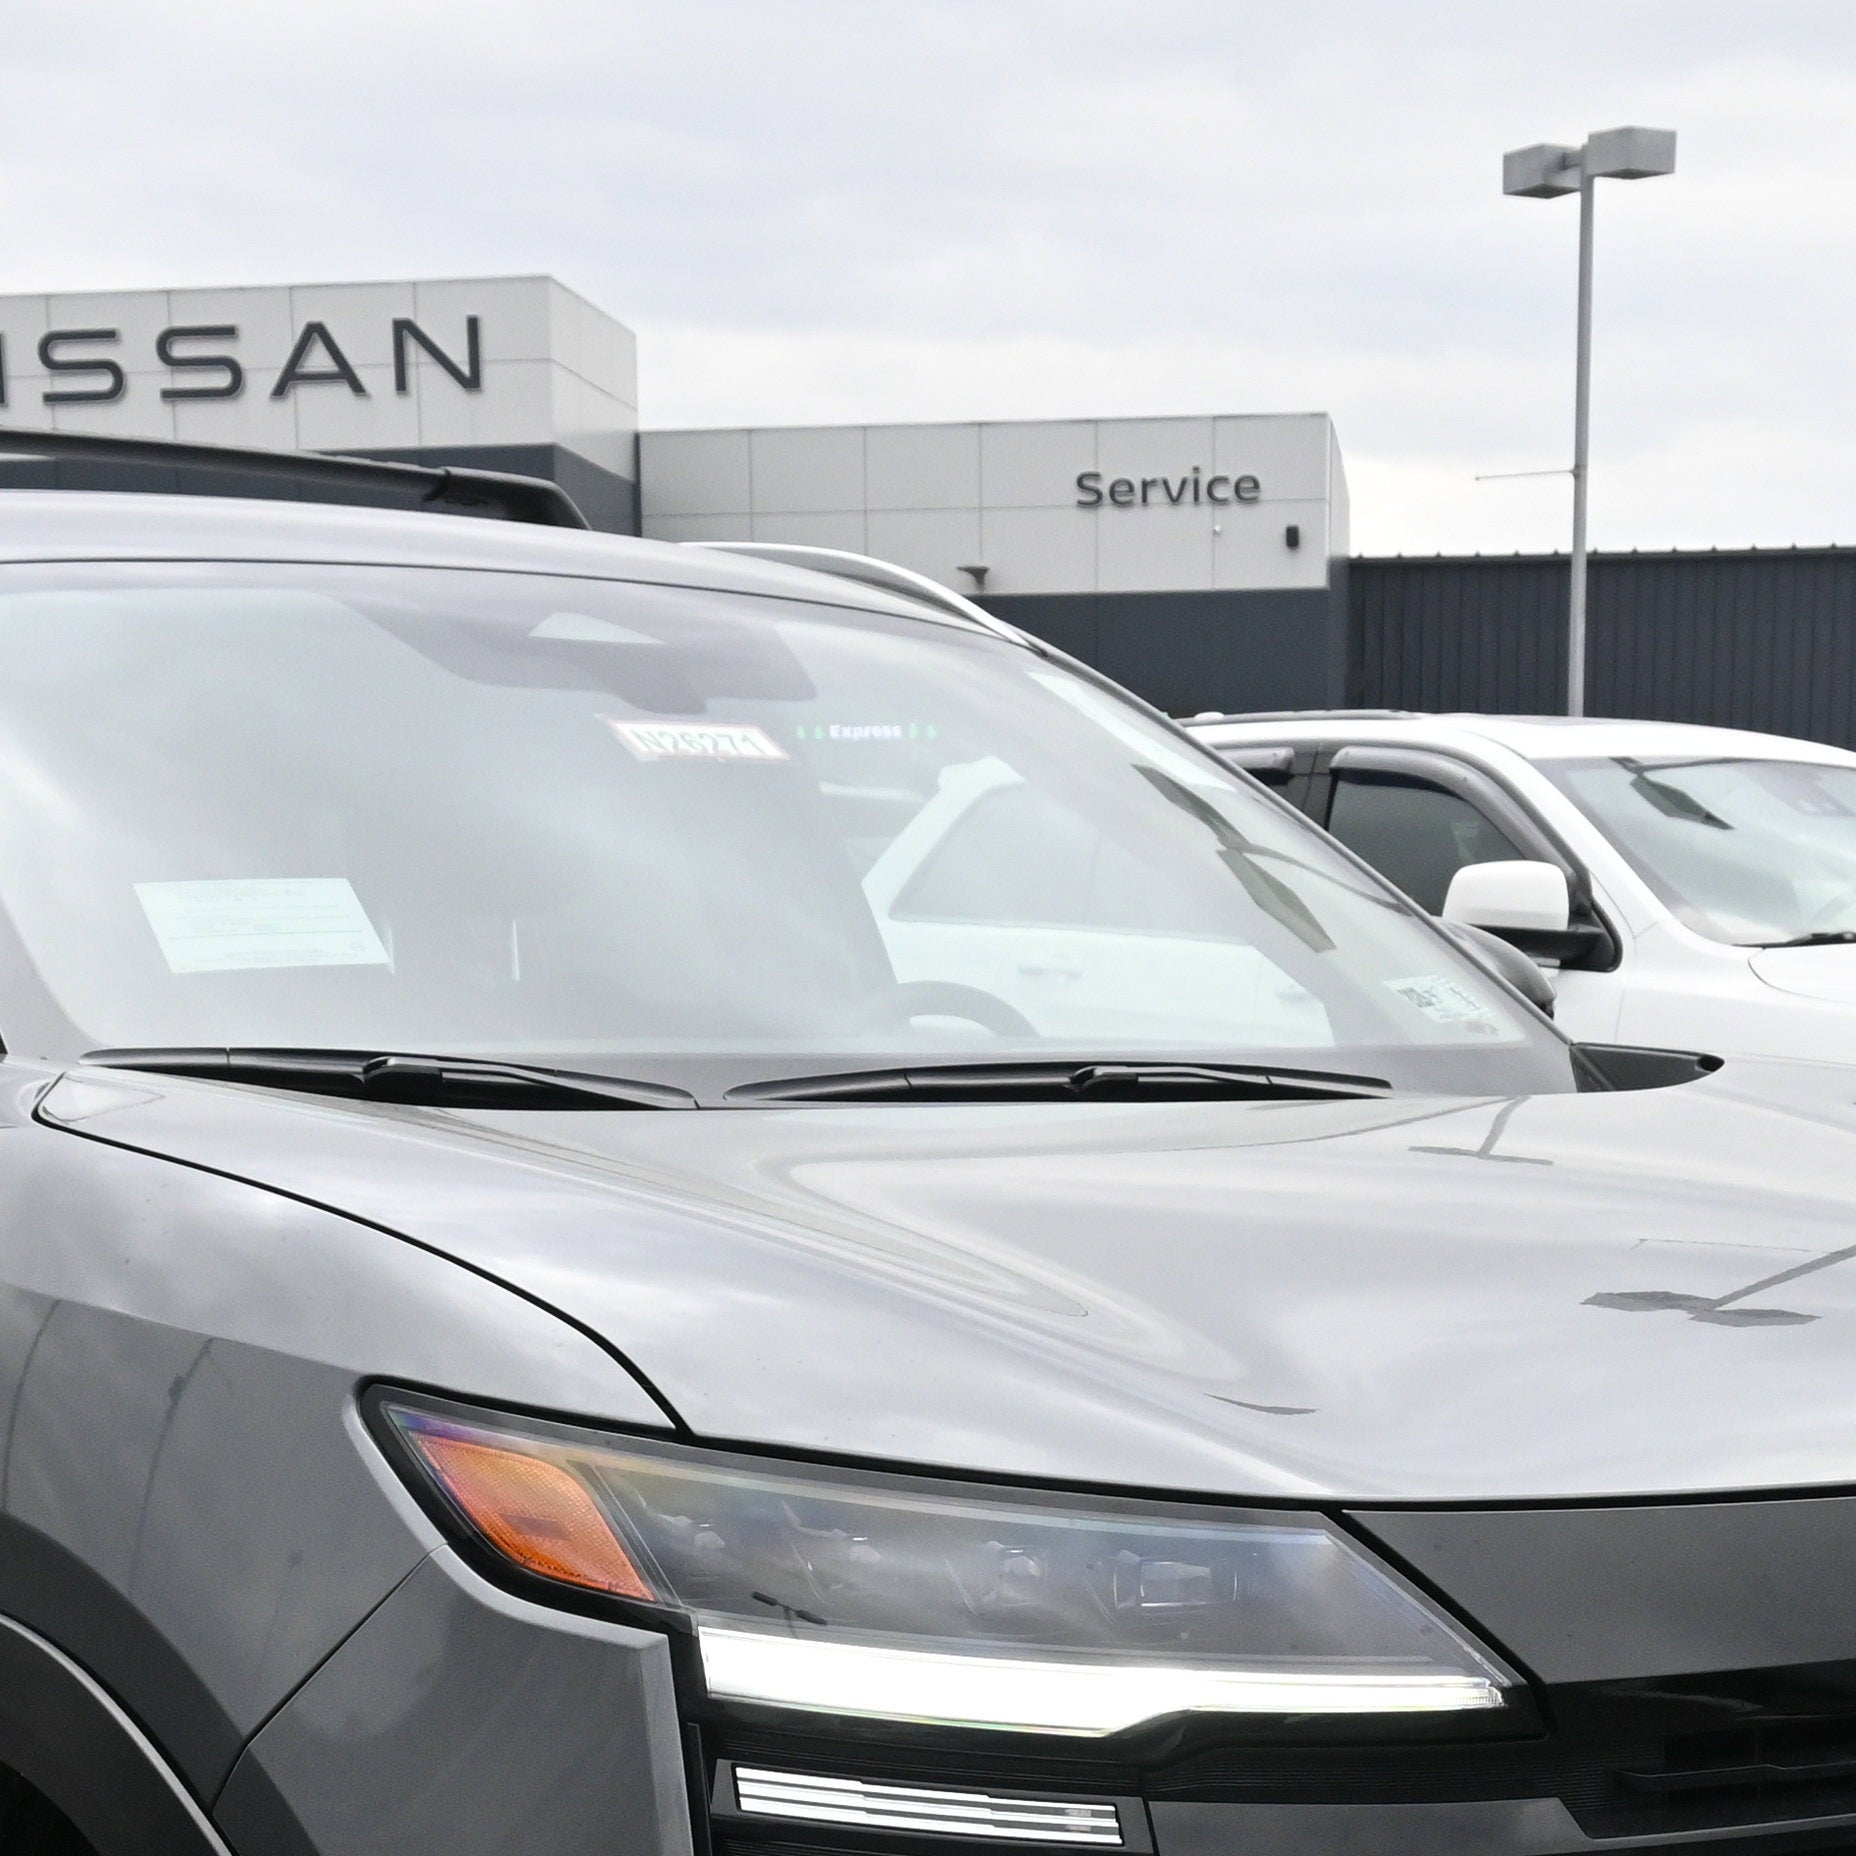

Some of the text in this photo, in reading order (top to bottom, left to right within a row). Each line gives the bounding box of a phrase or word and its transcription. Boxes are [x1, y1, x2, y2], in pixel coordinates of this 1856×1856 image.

[1075, 465, 1262, 508] Service
[630, 729, 768, 757] N26271
[830, 724, 902, 740] Express
